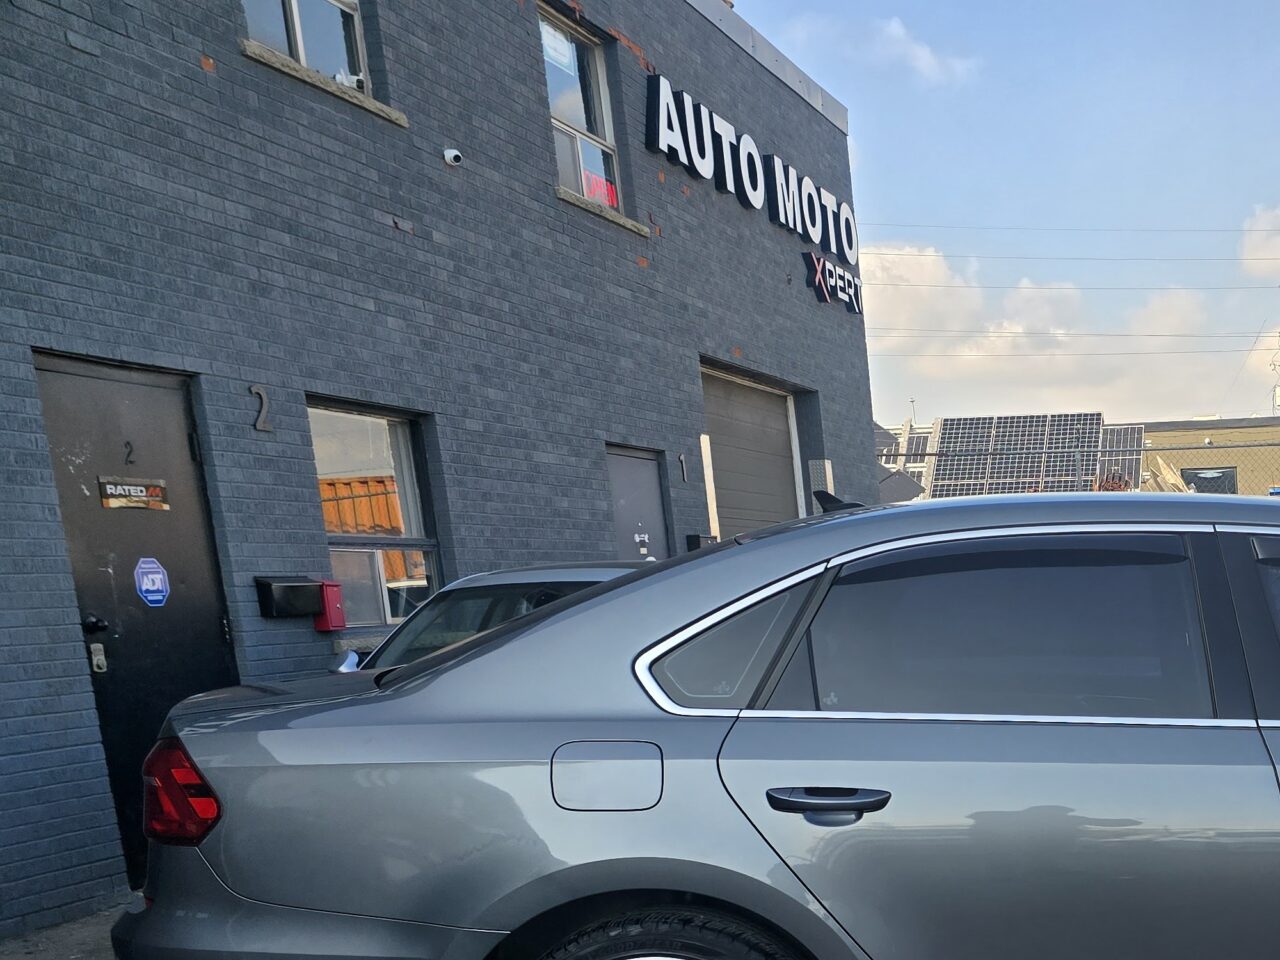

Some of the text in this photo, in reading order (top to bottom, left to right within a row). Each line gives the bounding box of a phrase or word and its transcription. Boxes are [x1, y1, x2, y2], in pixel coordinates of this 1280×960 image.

[658, 74, 859, 266] AUTO MOTO
[811, 252, 863, 313] XPERT
[250, 383, 274, 433] 2
[124, 440, 136, 466] 2
[678, 453, 687, 482] 1
[105, 484, 146, 496] RATED
[142, 574, 163, 591] ADT
